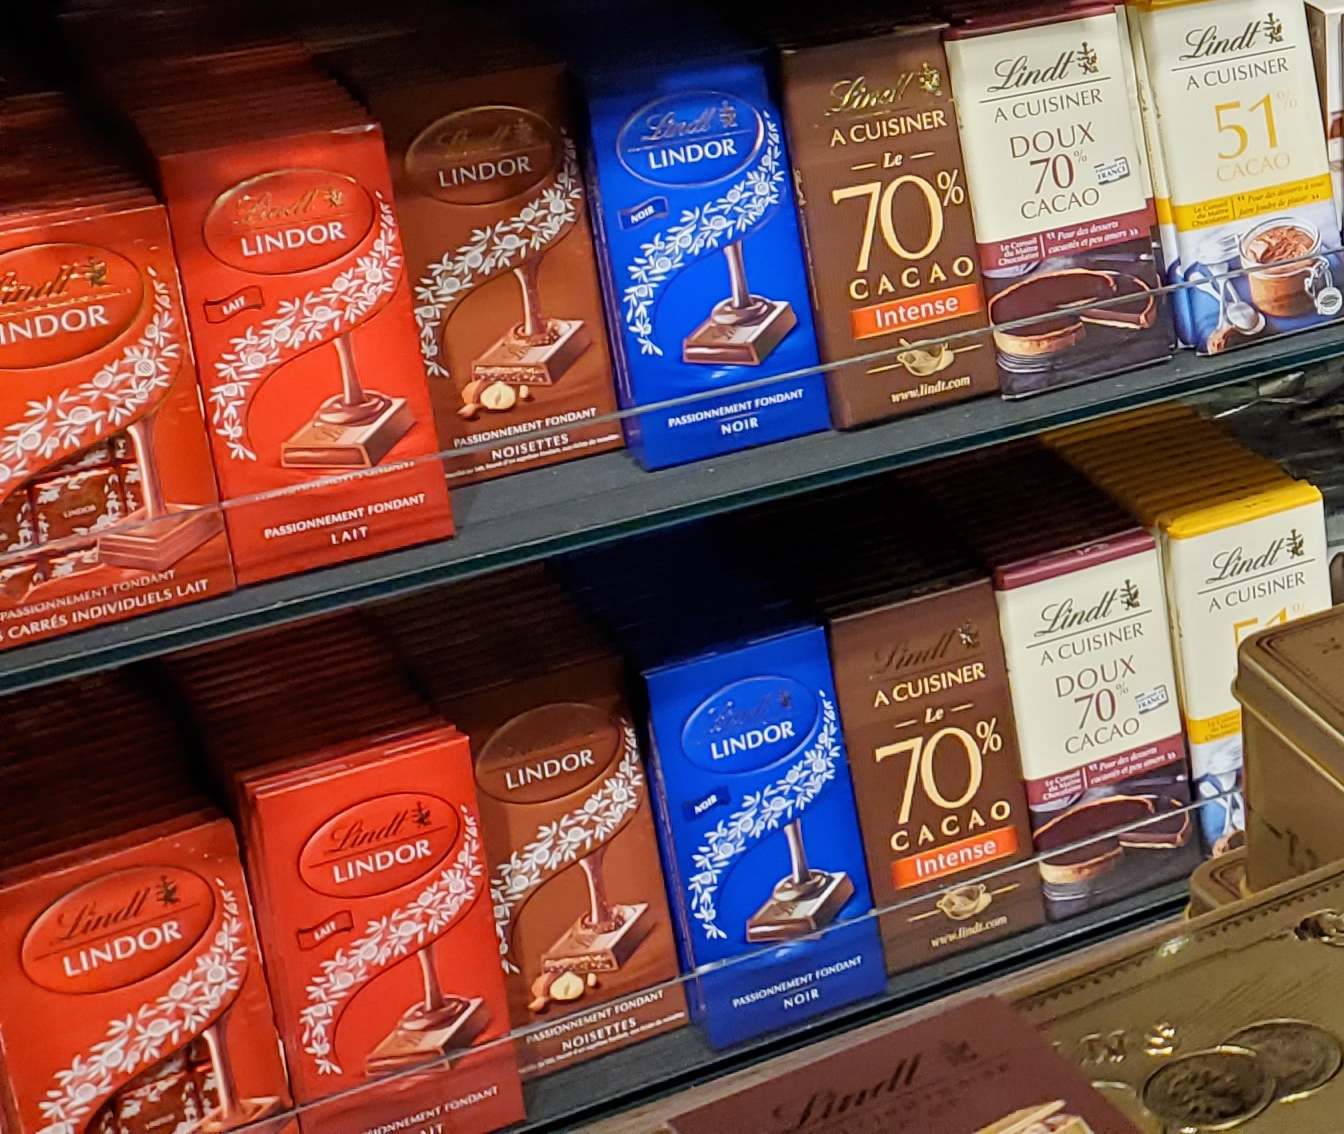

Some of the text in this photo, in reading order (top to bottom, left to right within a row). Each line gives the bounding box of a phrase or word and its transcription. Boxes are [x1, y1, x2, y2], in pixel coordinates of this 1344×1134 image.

[986, 47, 1077, 94] Lindt
[1186, 57, 1289, 91] A CUISINER
[993, 87, 1103, 124] A CUISINER
[829, 108, 948, 148] A CUISINER
[1008, 120, 1097, 159] DOUX
[438, 155, 532, 189] LINDOR
[648, 138, 738, 170] LINDOR
[1215, 151, 1292, 183] CACAO
[629, 204, 656, 224] NOIR
[831, 167, 966, 273] 70%
[1020, 186, 1101, 221] CACAO
[240, 220, 347, 258] LINDOR
[849, 255, 975, 301] CACAO
[221, 294, 246, 316] LAIT
[876, 293, 960, 329] Intense
[667, 387, 804, 428] PASSIONNEMENT FONDANT
[891, 374, 972, 404] www.lindt.com
[452, 405, 598, 448] PASSIONNEMENT FONDANT
[720, 415, 760, 436] NOIR
[490, 431, 570, 461] NOISETTES
[263, 492, 427, 540] PASSIONNEMENT FONDANT
[330, 524, 369, 546] LAIT
[1203, 540, 1288, 587] Lindt
[7, 577, 209, 641] CARRÉS INDIVIDUELS LAIT
[1208, 569, 1307, 614] A CUISINER
[1033, 589, 1121, 639] Lindt
[1040, 621, 1145, 666] A CUISINER
[873, 661, 986, 709] A CUISINER
[1054, 654, 1137, 699] DOUX
[709, 719, 797, 762] LINDOR
[1065, 716, 1141, 756] CACAO
[504, 747, 596, 790] LINDOR
[875, 716, 1004, 826] 70%
[693, 792, 719, 815] NOIR
[890, 799, 1012, 853] CACAO
[332, 838, 433, 885] LINDOR
[914, 836, 998, 878] Intense
[61, 919, 183, 978] LINDOR
[312, 920, 339, 942] LAIT
[929, 913, 1009, 950] www.lindt.com
[731, 954, 863, 1009] PASSIONNEMENT FONDANT
[782, 986, 821, 1011] NOIR
[560, 1016, 639, 1052] NOISETTES
[444, 1085, 499, 1114] FONDANT
